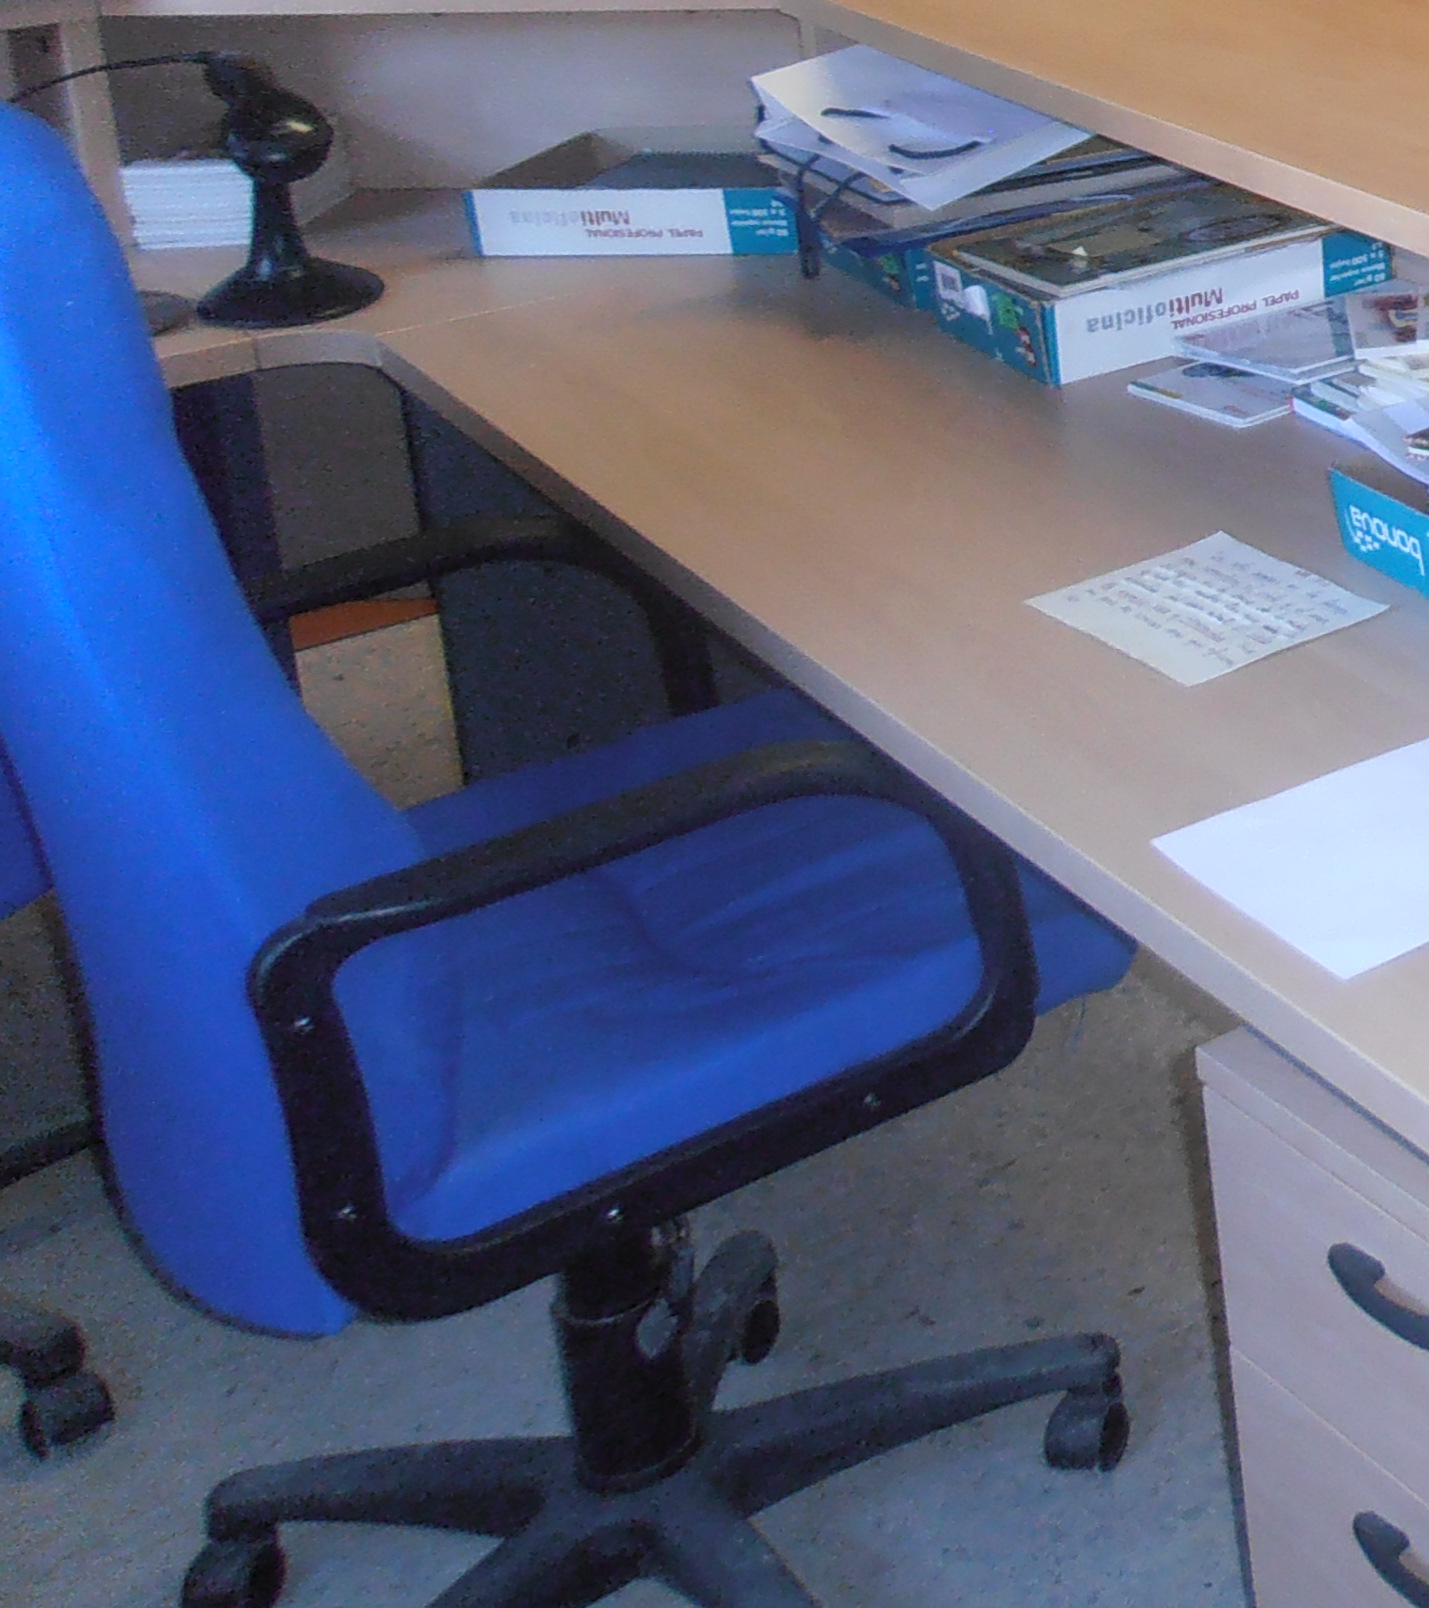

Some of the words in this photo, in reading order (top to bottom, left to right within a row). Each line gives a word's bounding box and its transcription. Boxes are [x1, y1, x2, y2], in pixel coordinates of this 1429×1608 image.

[509, 209, 631, 228] Multioficina
[584, 228, 665, 239] PROFESIONAL
[666, 228, 704, 239] PAPEL
[1262, 289, 1300, 309] PAPEL
[1086, 287, 1224, 334] Multioficina
[1171, 300, 1258, 330] PROFESIONAL
[1349, 504, 1425, 576] bonova
